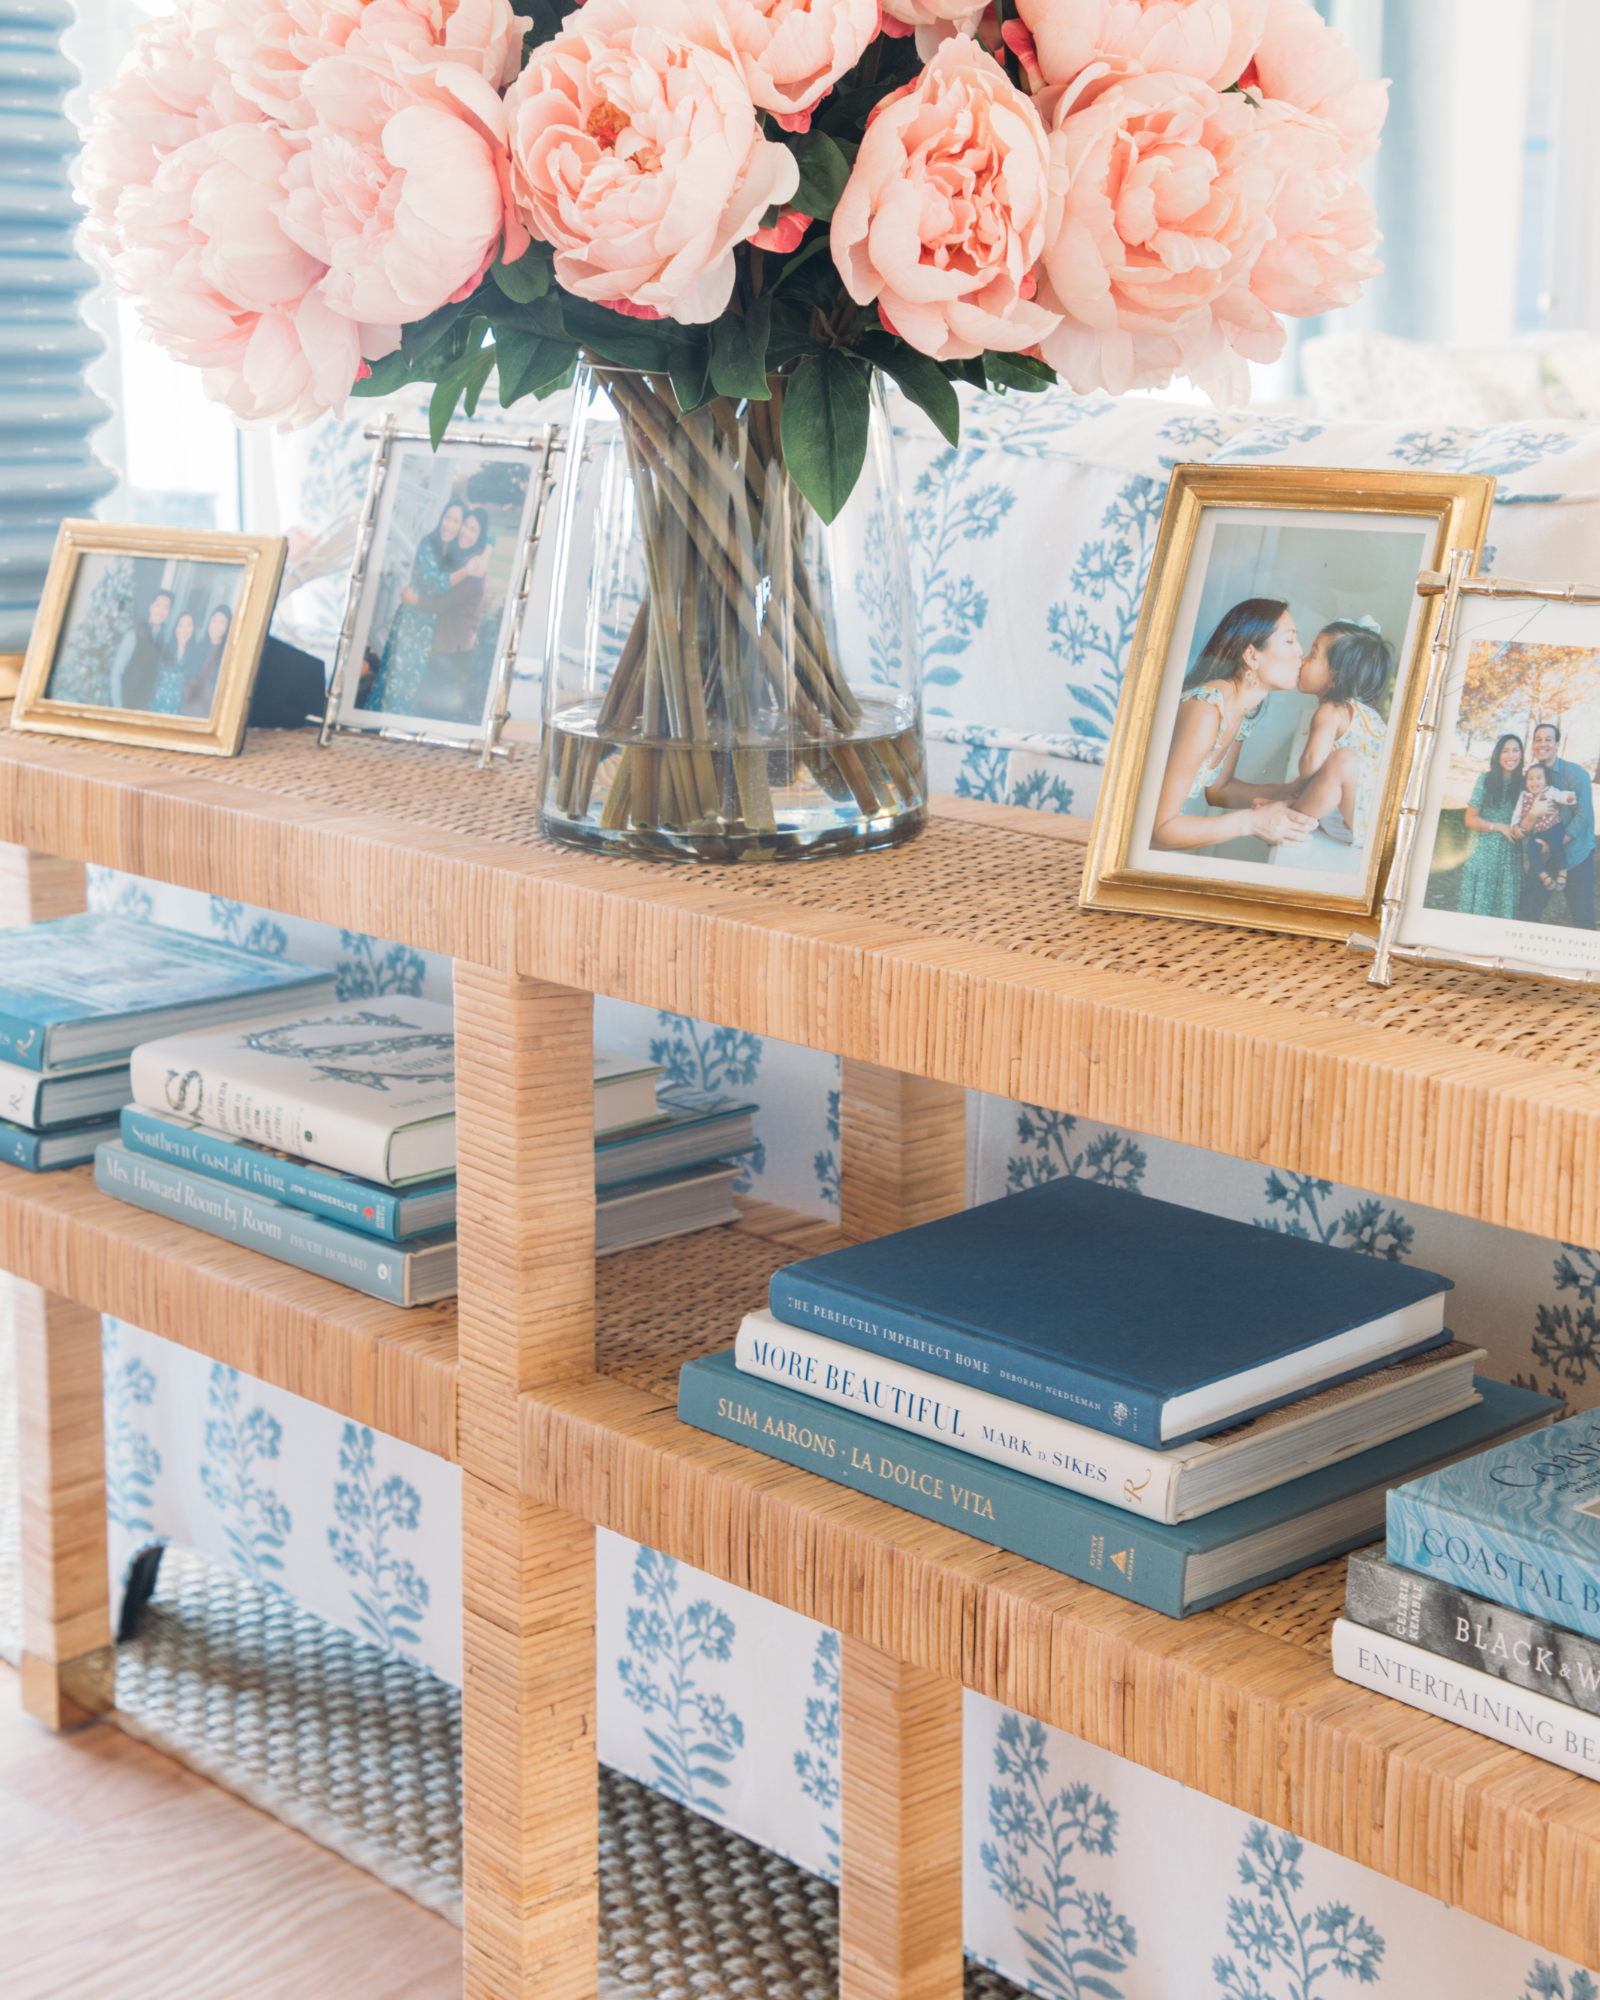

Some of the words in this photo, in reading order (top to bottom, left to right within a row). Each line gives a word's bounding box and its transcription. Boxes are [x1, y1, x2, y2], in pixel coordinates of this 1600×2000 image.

[1505, 930, 1523, 938] THE
[1529, 934, 1562, 944] OWENS
[1556, 950, 1600, 961] ninetee
[217, 1081, 228, 1132] SOUTHERN
[254, 1109, 262, 1131] FROM
[131, 1123, 191, 1160] Southern
[192, 1144, 242, 1178] Coastal
[244, 1160, 286, 1196] Living
[289, 1183, 307, 1196] JONI
[308, 1189, 358, 1213] VANDERSLICE
[133, 1166, 183, 1203] Howard
[184, 1185, 222, 1219] Room
[224, 1198, 240, 1231] by
[243, 1206, 282, 1241] Room
[289, 1233, 323, 1256] PHOEBE
[325, 1247, 367, 1271] HOWARD
[787, 1296, 810, 1313] THE
[814, 1304, 880, 1336] PERFECTLY
[883, 1328, 952, 1361] IMPERFECT
[955, 1352, 990, 1375] HOME
[1000, 1370, 1043, 1391] DEBORAH
[1045, 1386, 1102, 1411] NEEDLEMAN
[750, 1337, 819, 1384] MORE
[825, 1363, 966, 1438] BEAUTIFUL
[980, 1424, 1033, 1457] MARK
[1052, 1450, 1108, 1483] SIKES
[717, 1397, 759, 1430] SLIM
[761, 1415, 837, 1458] AARONS
[850, 1446, 874, 1474] LA
[879, 1457, 944, 1501] DOLCE
[950, 1484, 996, 1521] VITA
[1123, 1468, 1152, 1503] R
[1489, 1426, 1600, 1488] Coast
[1127, 1546, 1135, 1582] ABRAMS
[1421, 1527, 1573, 1606] COASTAL
[1396, 1577, 1410, 1636] CELERIE
[1410, 1582, 1423, 1641] KEMBLE
[1455, 1616, 1554, 1676] BLACK
[1559, 1663, 1572, 1680] &
[1358, 1646, 1555, 1745] ENTERTAINING
[1564, 1728, 1600, 1764] BE
